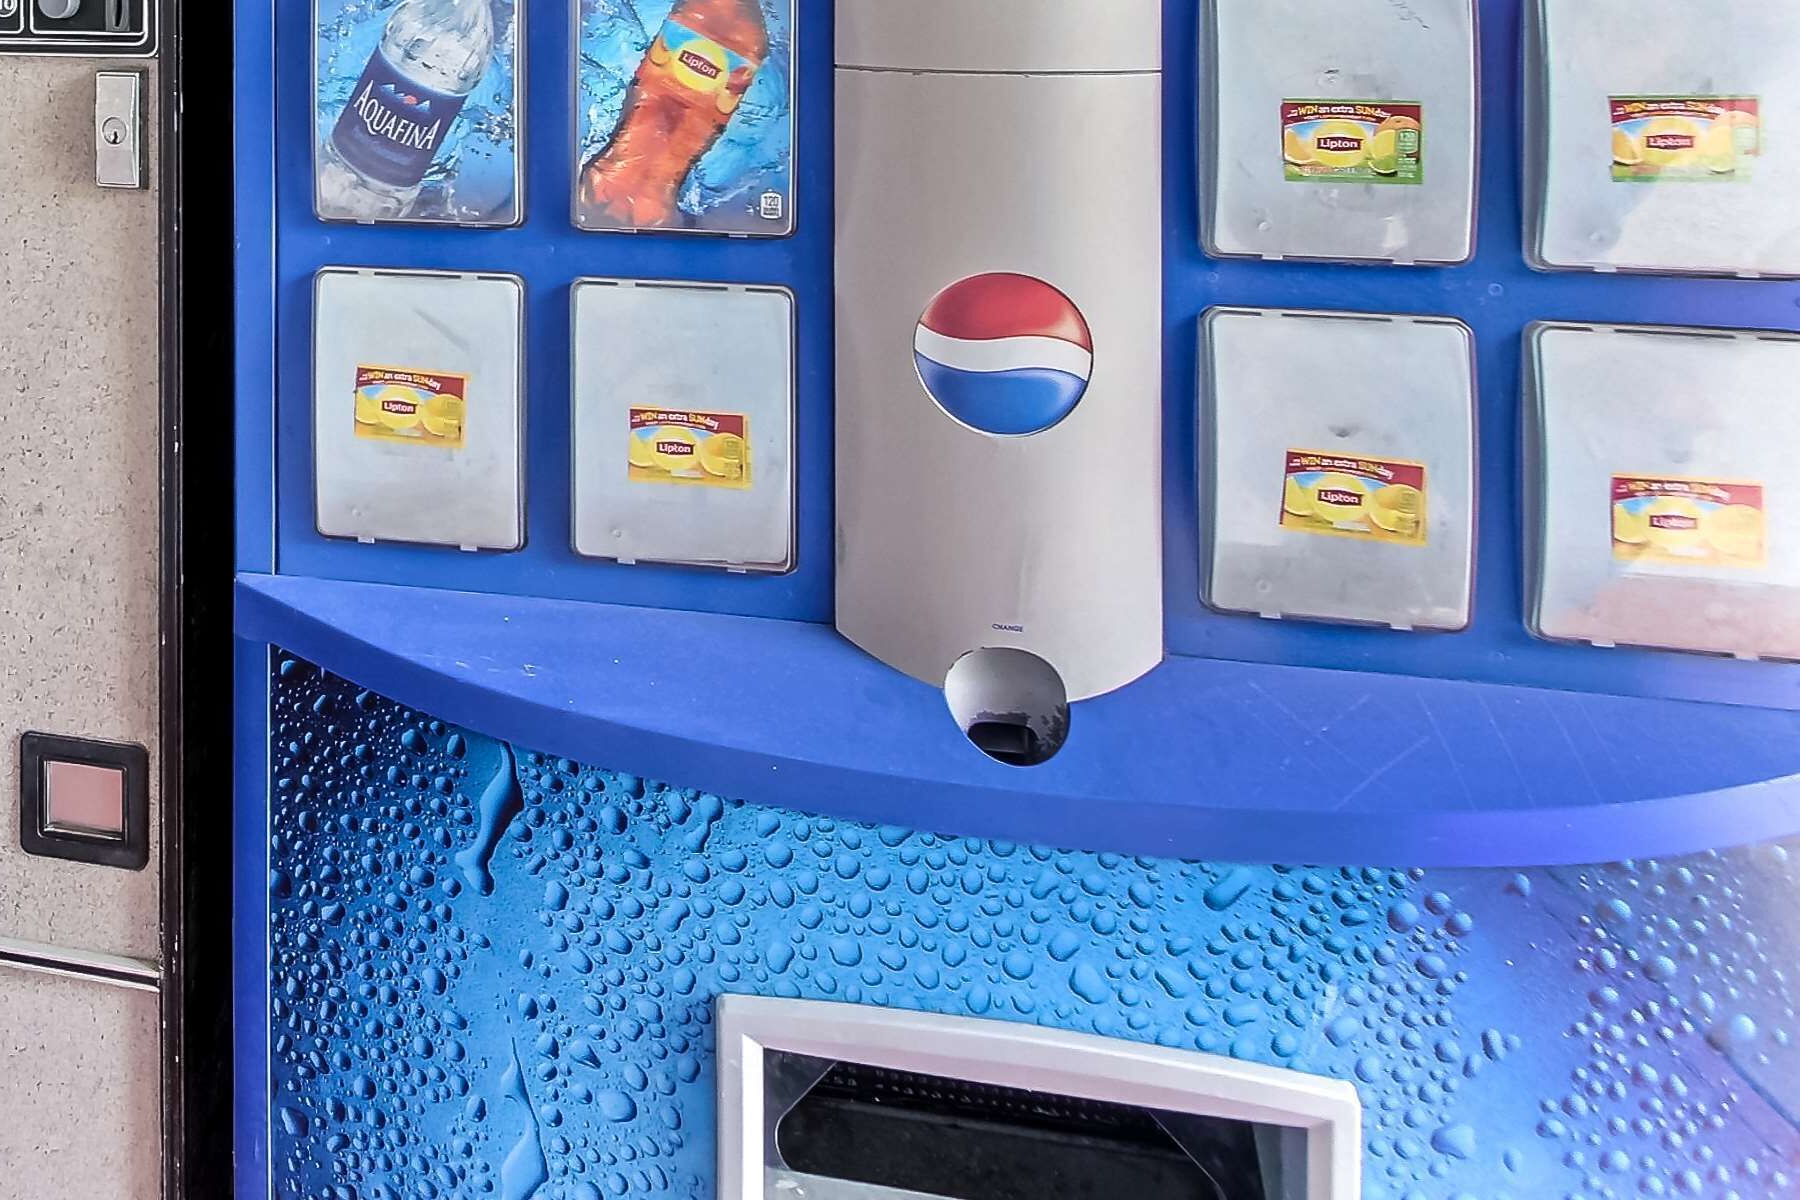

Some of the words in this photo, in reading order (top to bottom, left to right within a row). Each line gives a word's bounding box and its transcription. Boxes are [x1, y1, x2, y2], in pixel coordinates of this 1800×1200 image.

[681, 52, 718, 77] Lipton
[353, 79, 441, 150] AQUAFINA
[1320, 138, 1358, 151] Lipton
[384, 402, 414, 413] Lipton
[659, 444, 691, 454] Lipton
[1320, 491, 1359, 504] Lipton
[992, 623, 1024, 632] CHANGE
